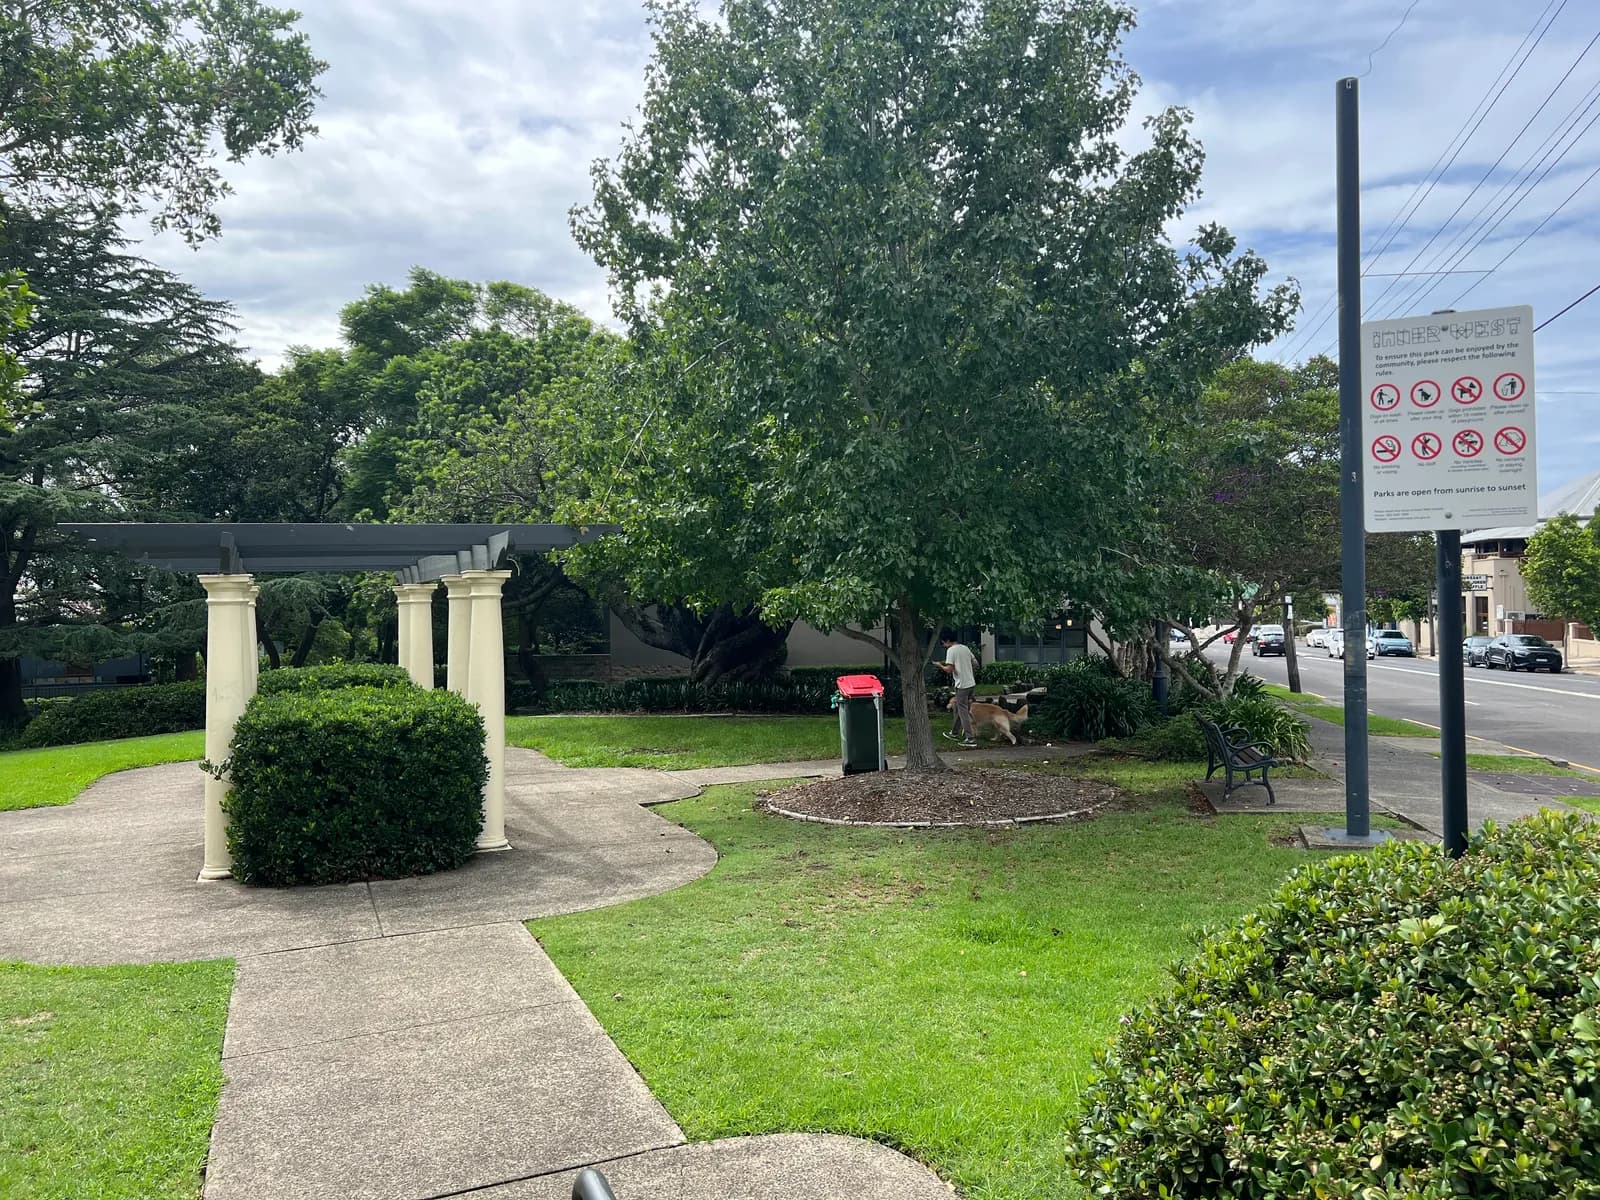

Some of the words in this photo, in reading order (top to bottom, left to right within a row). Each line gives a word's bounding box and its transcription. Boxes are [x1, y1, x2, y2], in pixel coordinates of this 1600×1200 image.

[1373, 325, 1441, 349] INNER
[1450, 317, 1521, 340] WEST
[1376, 360, 1415, 369] community,
[1416, 357, 1438, 366] please
[1440, 355, 1466, 364] respect
[1482, 350, 1516, 359] following
[1409, 351, 1422, 359] this
[1424, 350, 1439, 358] park
[1466, 344, 1494, 354] enjoyed
[1496, 343, 1505, 351] by
[1412, 489, 1431, 497] open
[1456, 486, 1485, 494] sunrise
